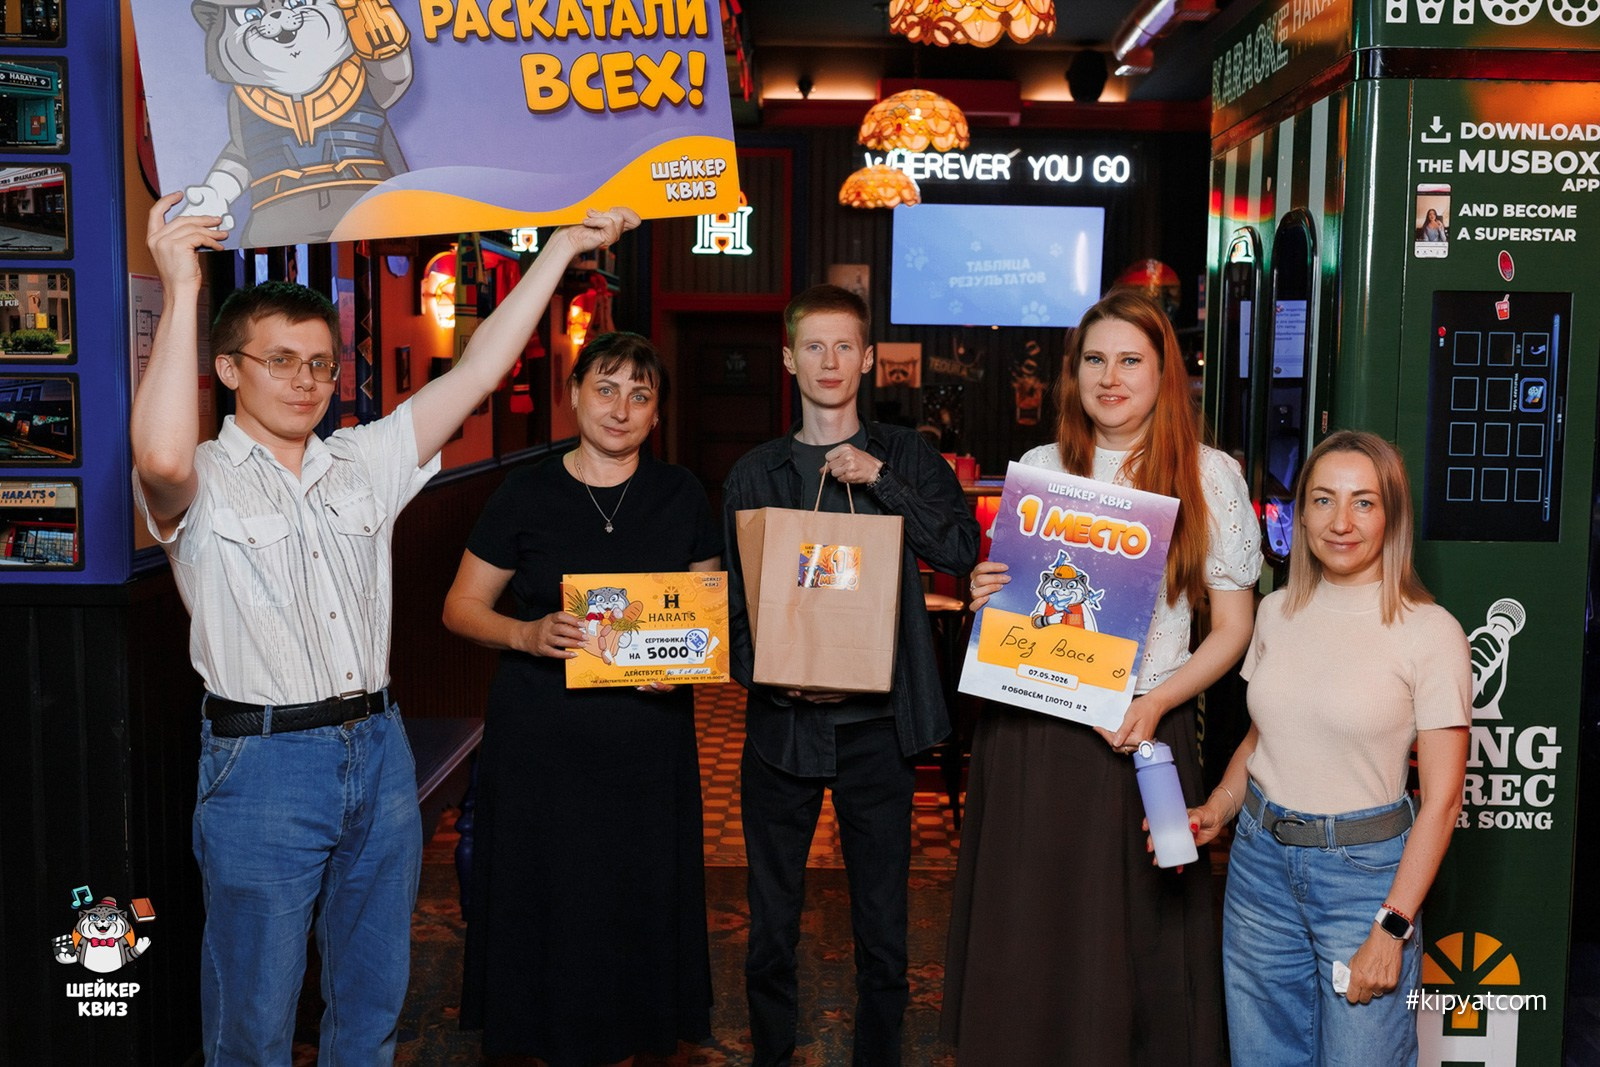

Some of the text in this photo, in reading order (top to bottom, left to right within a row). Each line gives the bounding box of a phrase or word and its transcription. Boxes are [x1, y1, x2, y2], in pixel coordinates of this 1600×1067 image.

[420, 0, 708, 42] РАСКАТАЛИ
[1212, 3, 1289, 113] KARAOKE
[520, 50, 706, 115] ВСЕХ!
[1460, 122, 1600, 141] DOWNLOAD
[651, 155, 727, 180] ШЕЙКЕР
[1028, 155, 1083, 183] YOU
[1092, 155, 1131, 184] GO
[1417, 149, 1600, 175] THE MUSBOX
[665, 180, 717, 201] КВИЗ
[1562, 178, 1600, 192] APP
[1458, 203, 1577, 218] AND BECOME
[1457, 227, 1577, 242] A SUPERSTAR
[966, 258, 1031, 273] ТАБЛИЦА
[949, 271, 1046, 289] РЕЗУЛЬТАТОВ
[1047, 483, 1133, 510] ШЕЙКЕР КВИЗ
[1019, 496, 1149, 557] 1 МЕСТО
[819, 574, 857, 588] МЕО
[629, 652, 641, 660] НА
[647, 646, 689, 659] 5000
[1000, 626, 1095, 664] Без Вась
[624, 668, 665, 677] ДЕЙСТВУЕТ:
[1028, 668, 1069, 685] 07.05.2026
[1045, 694, 1073, 710] [ЛОТО]
[1076, 703, 1088, 713] #2
[1467, 725, 1562, 770] NG
[1462, 774, 1555, 807] REC
[1478, 811, 1553, 830] SONG
